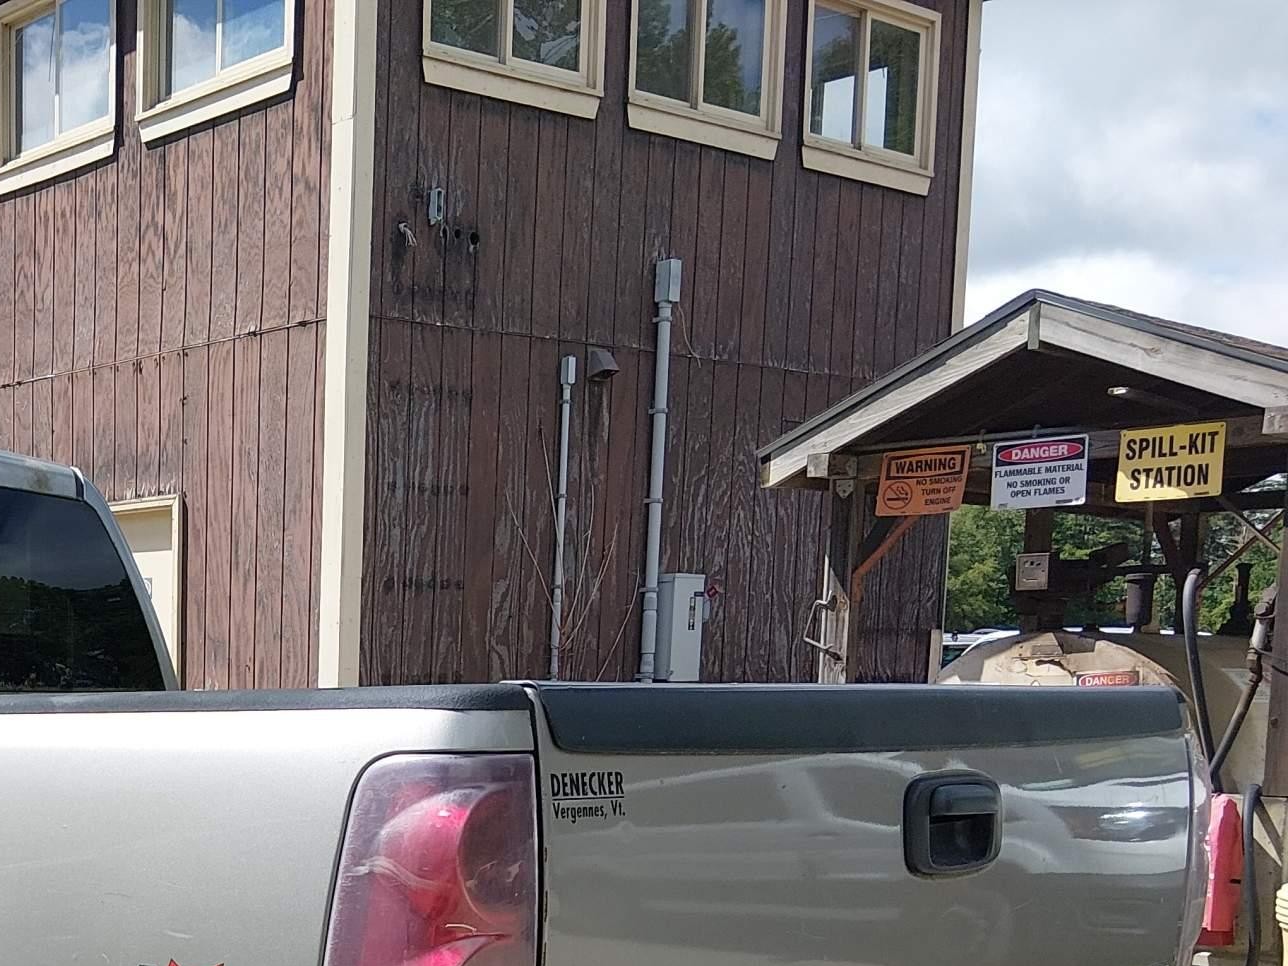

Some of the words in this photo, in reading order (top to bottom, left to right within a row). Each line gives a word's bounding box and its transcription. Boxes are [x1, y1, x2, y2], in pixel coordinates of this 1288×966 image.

[1011, 444, 1069, 461] DANGER
[1125, 430, 1219, 461] SPILL-KIT
[895, 456, 957, 475] WARNING
[995, 466, 1043, 479] FLAMMABLE
[1045, 462, 1085, 474] MATERIAL
[915, 478, 928, 487] NO
[929, 476, 963, 486] SMOKING
[1006, 480, 1018, 489] NO
[1020, 477, 1057, 488] SMOKING
[1058, 476, 1071, 486] OR
[1130, 463, 1210, 491] STATION
[921, 487, 942, 496] TURN
[943, 485, 956, 495] OFF
[1010, 489, 1031, 499] OPEN
[1033, 486, 1065, 497] FLAMES
[924, 496, 952, 506] ENGINE
[1085, 674, 1130, 687] DANGER
[550, 771, 625, 798] DENECKER
[552, 802, 608, 824] Vergennes,
[610, 799, 626, 817] Vt.
